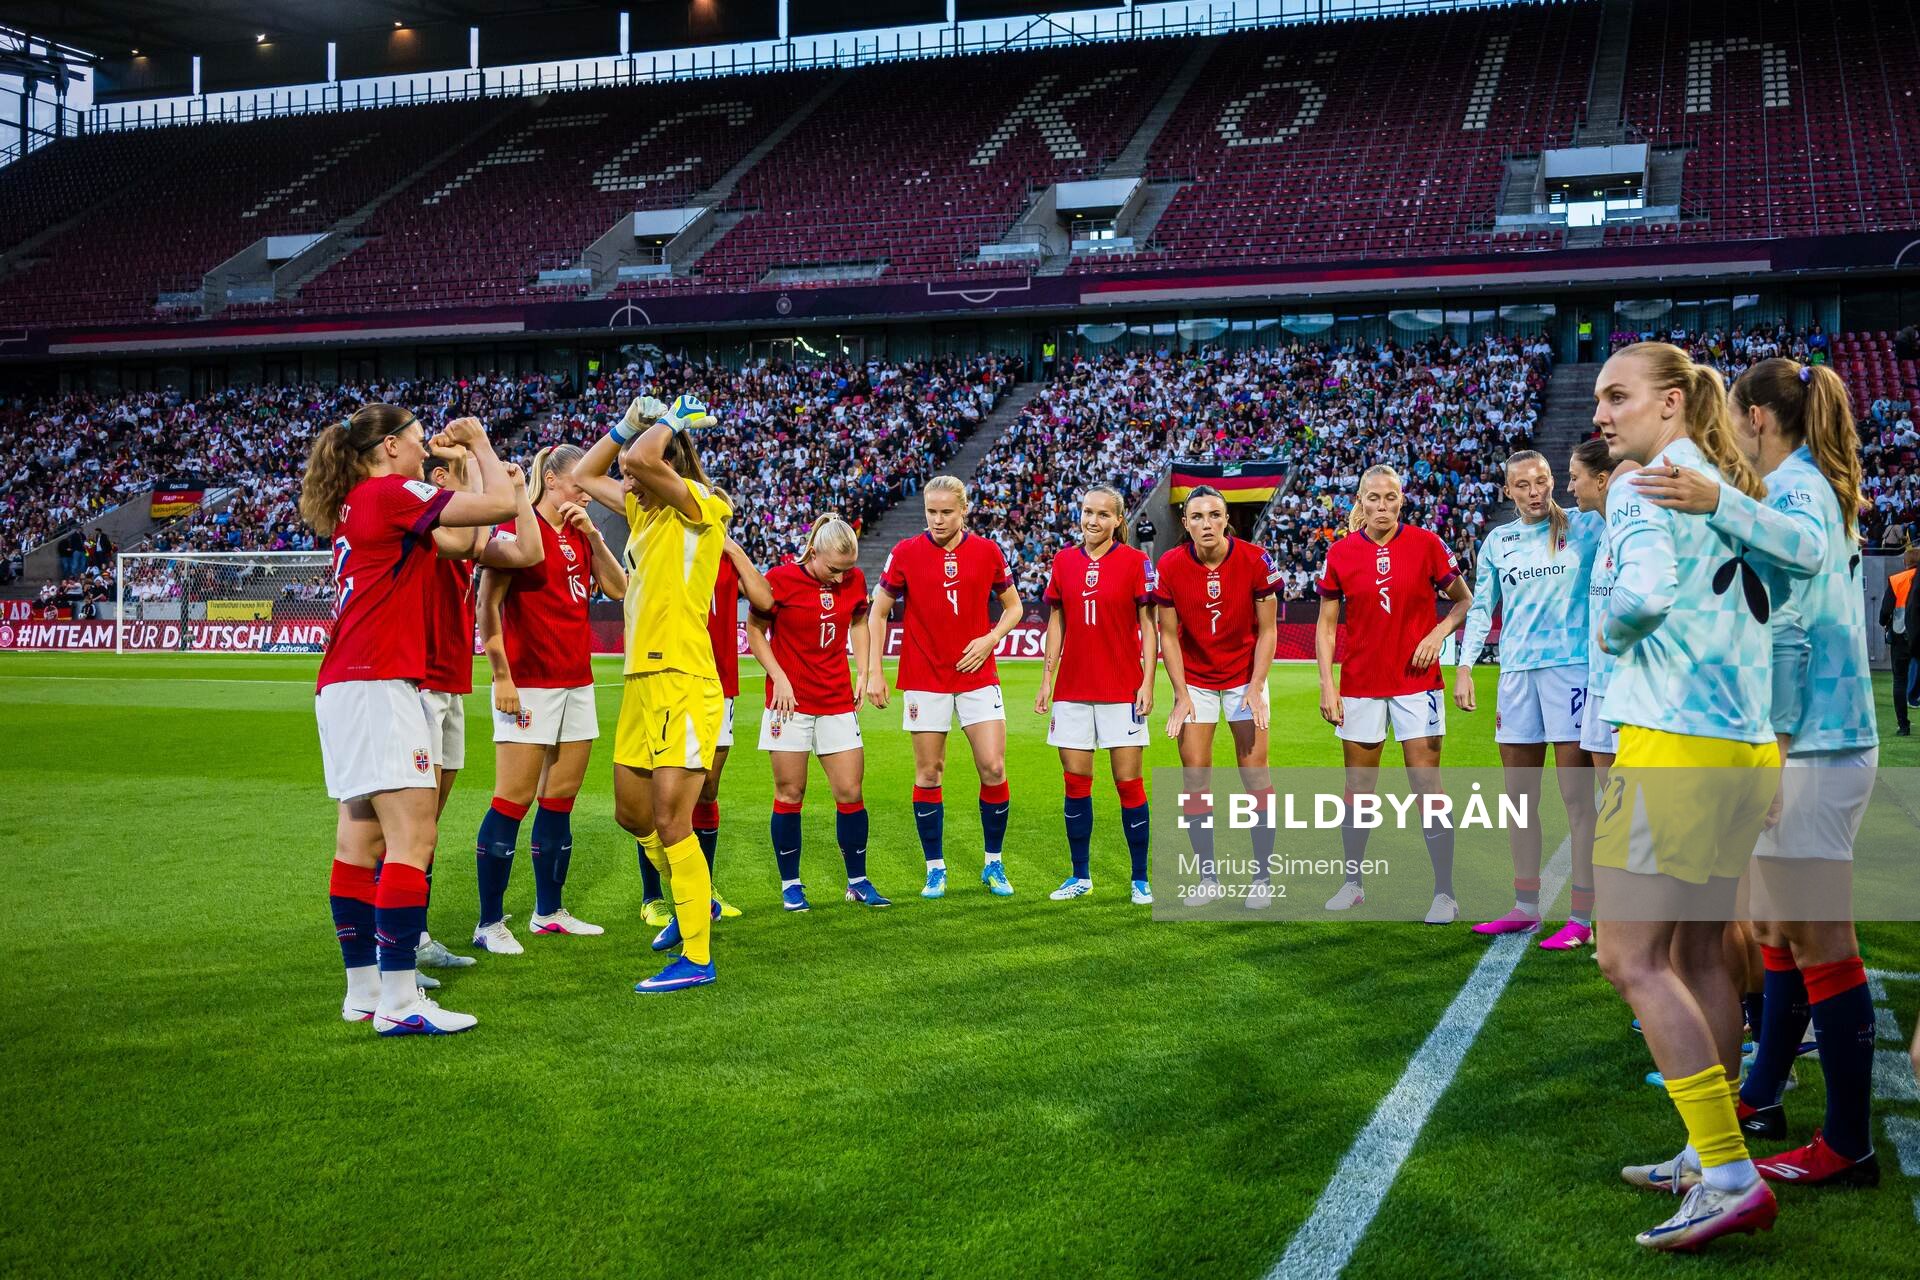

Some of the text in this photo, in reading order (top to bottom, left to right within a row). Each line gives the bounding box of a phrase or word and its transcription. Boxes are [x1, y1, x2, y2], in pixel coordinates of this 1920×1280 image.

[1518, 564, 1567, 580] telenor
[567, 574, 588, 604] 16
[946, 589, 959, 616] 4
[1379, 587, 1392, 614] 5
[1083, 599, 1097, 626] 11
[1210, 609, 1222, 636] 7
[16, 625, 114, 648] #IMTEAM
[120, 620, 158, 648] FÜR
[819, 622, 836, 649] 13
[661, 710, 670, 742] 1
